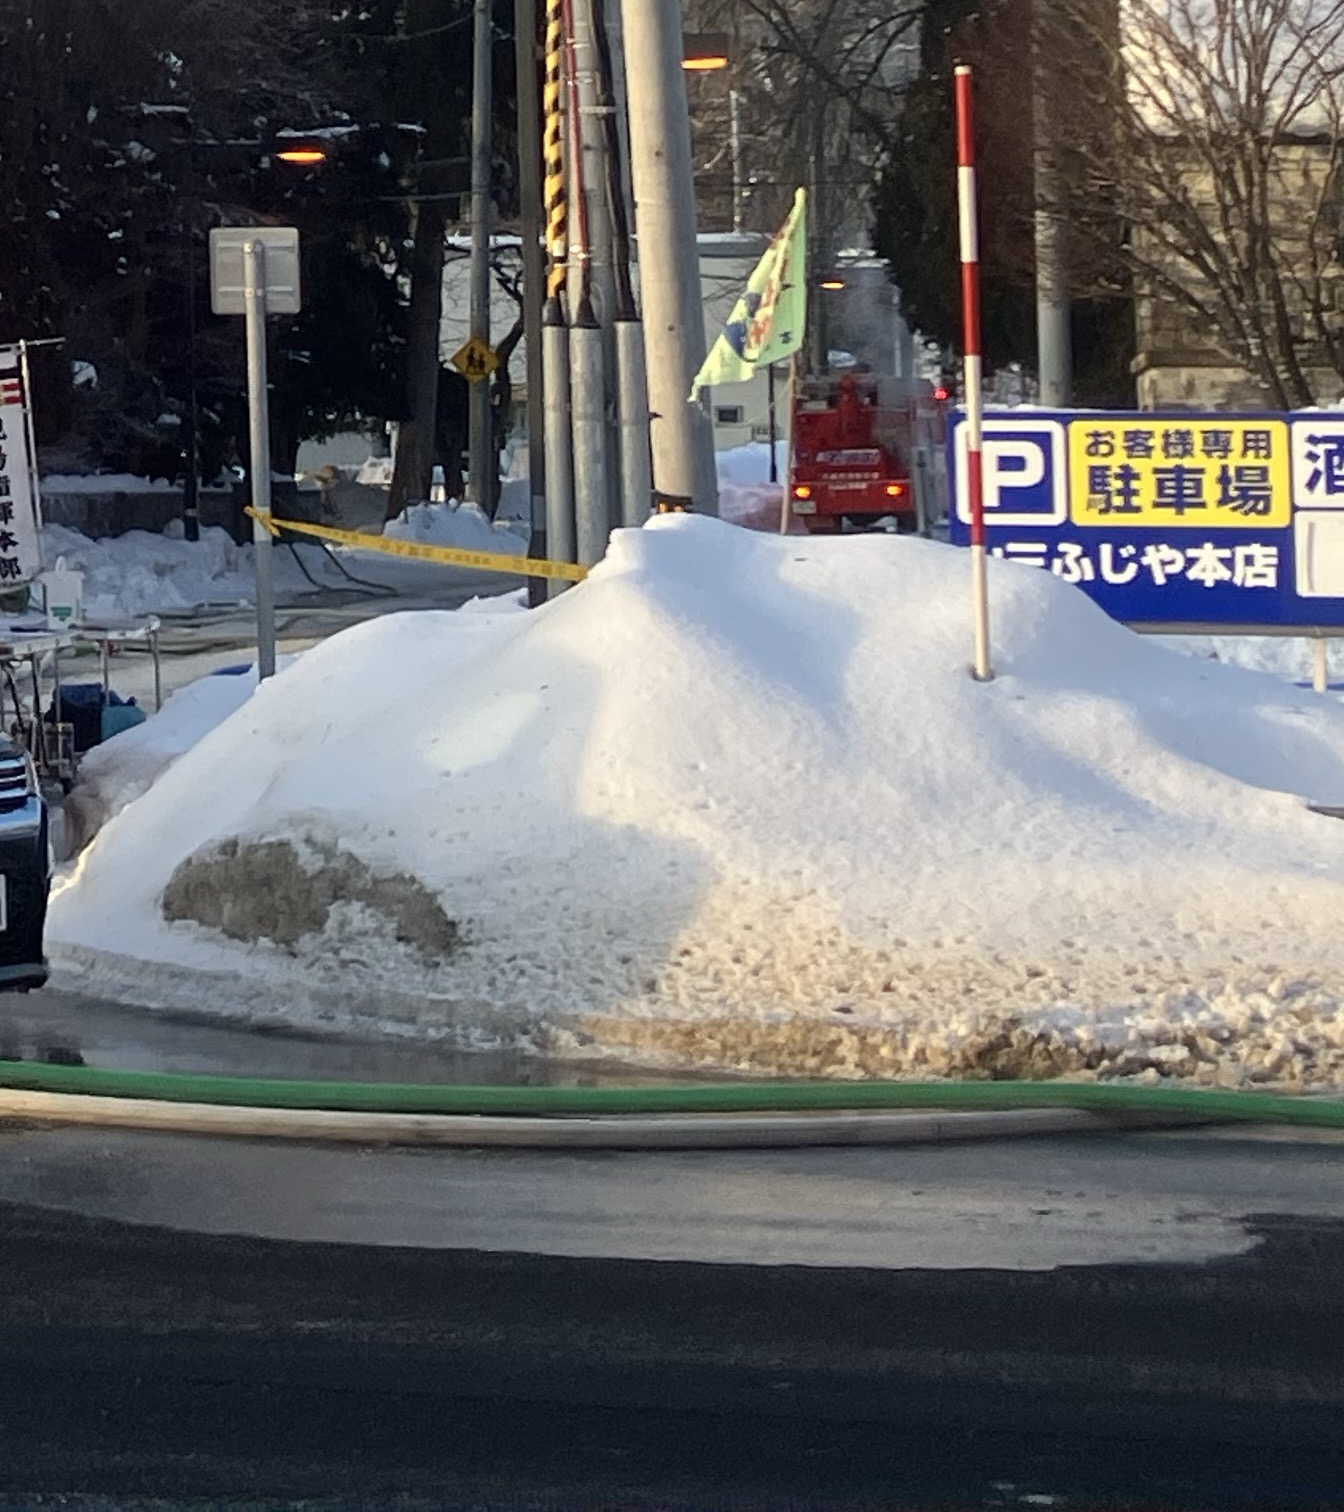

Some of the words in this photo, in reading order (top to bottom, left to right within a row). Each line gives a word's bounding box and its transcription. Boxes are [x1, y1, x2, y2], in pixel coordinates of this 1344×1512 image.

[1084, 429, 1273, 460] お客様専用
[980, 439, 1045, 508] P
[1085, 463, 1274, 516] 駐車場
